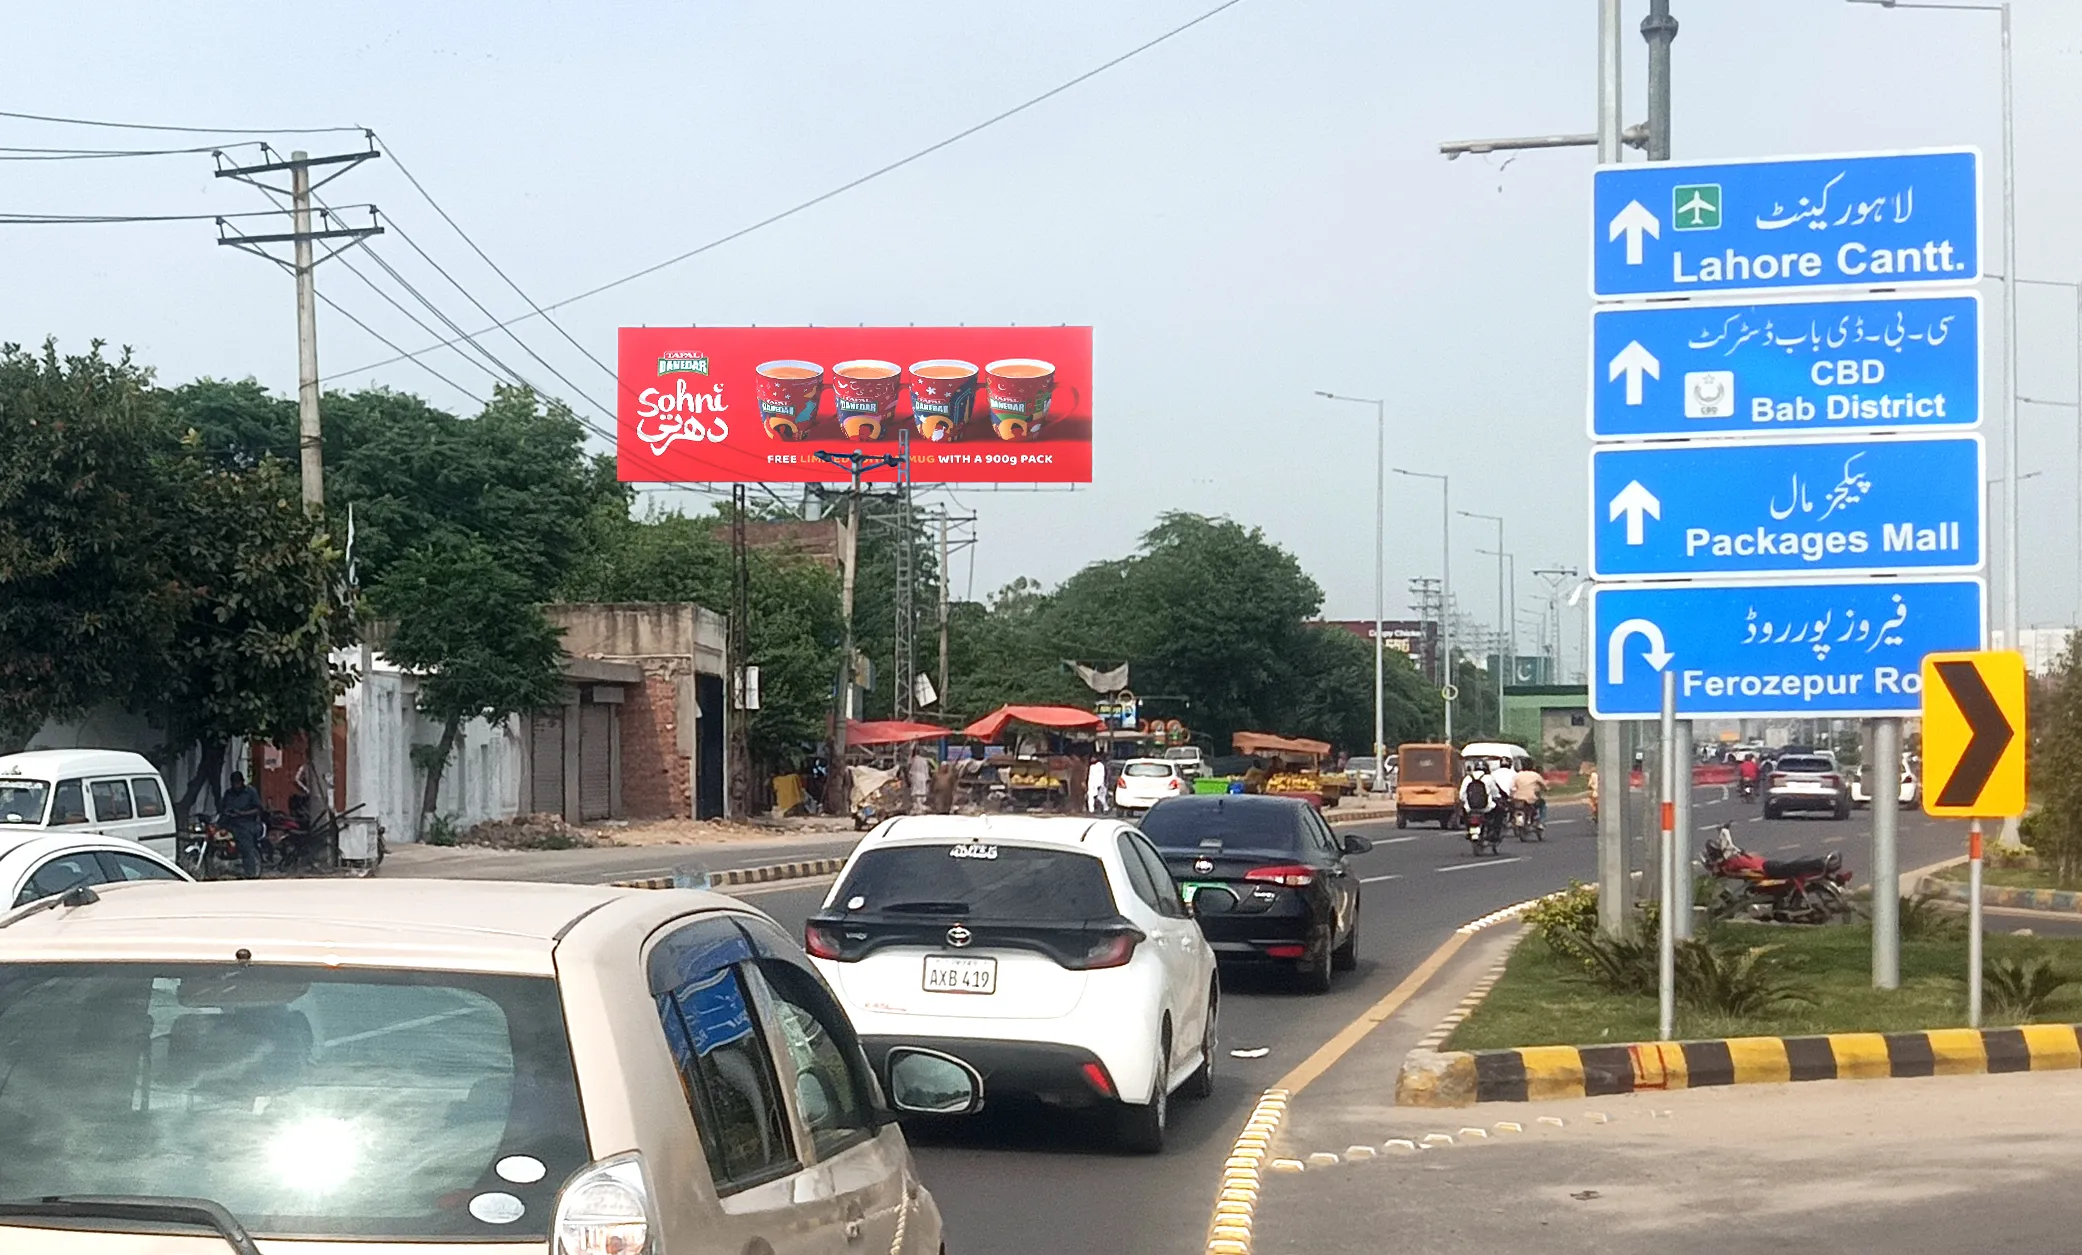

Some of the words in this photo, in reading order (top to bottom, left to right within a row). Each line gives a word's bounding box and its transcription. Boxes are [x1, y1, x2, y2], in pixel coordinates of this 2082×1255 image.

[1755, 170, 1847, 231] کینٹ
[1832, 185, 1914, 227] لاہور
[1673, 248, 1822, 284] Lahore
[1837, 239, 1966, 276] Cantt.
[659, 360, 707, 374] DANEDAR
[1811, 359, 1886, 386] CBD
[637, 378, 729, 418] Sohni
[1751, 396, 1816, 423] Bab
[1826, 393, 1947, 421] District
[767, 454, 797, 464] FREE
[938, 454, 971, 464] WITH
[973, 454, 983, 464] A
[985, 454, 1018, 466] 900g
[1020, 454, 1053, 464] PACK
[1770, 471, 1814, 520] مال
[1686, 526, 1870, 562] Packages
[1883, 521, 1960, 552] Mall
[1683, 666, 1864, 702] Ferozepur
[1874, 666, 1922, 694] Ro
[929, 969, 958, 987] AXB
[962, 970, 990, 988] 419
